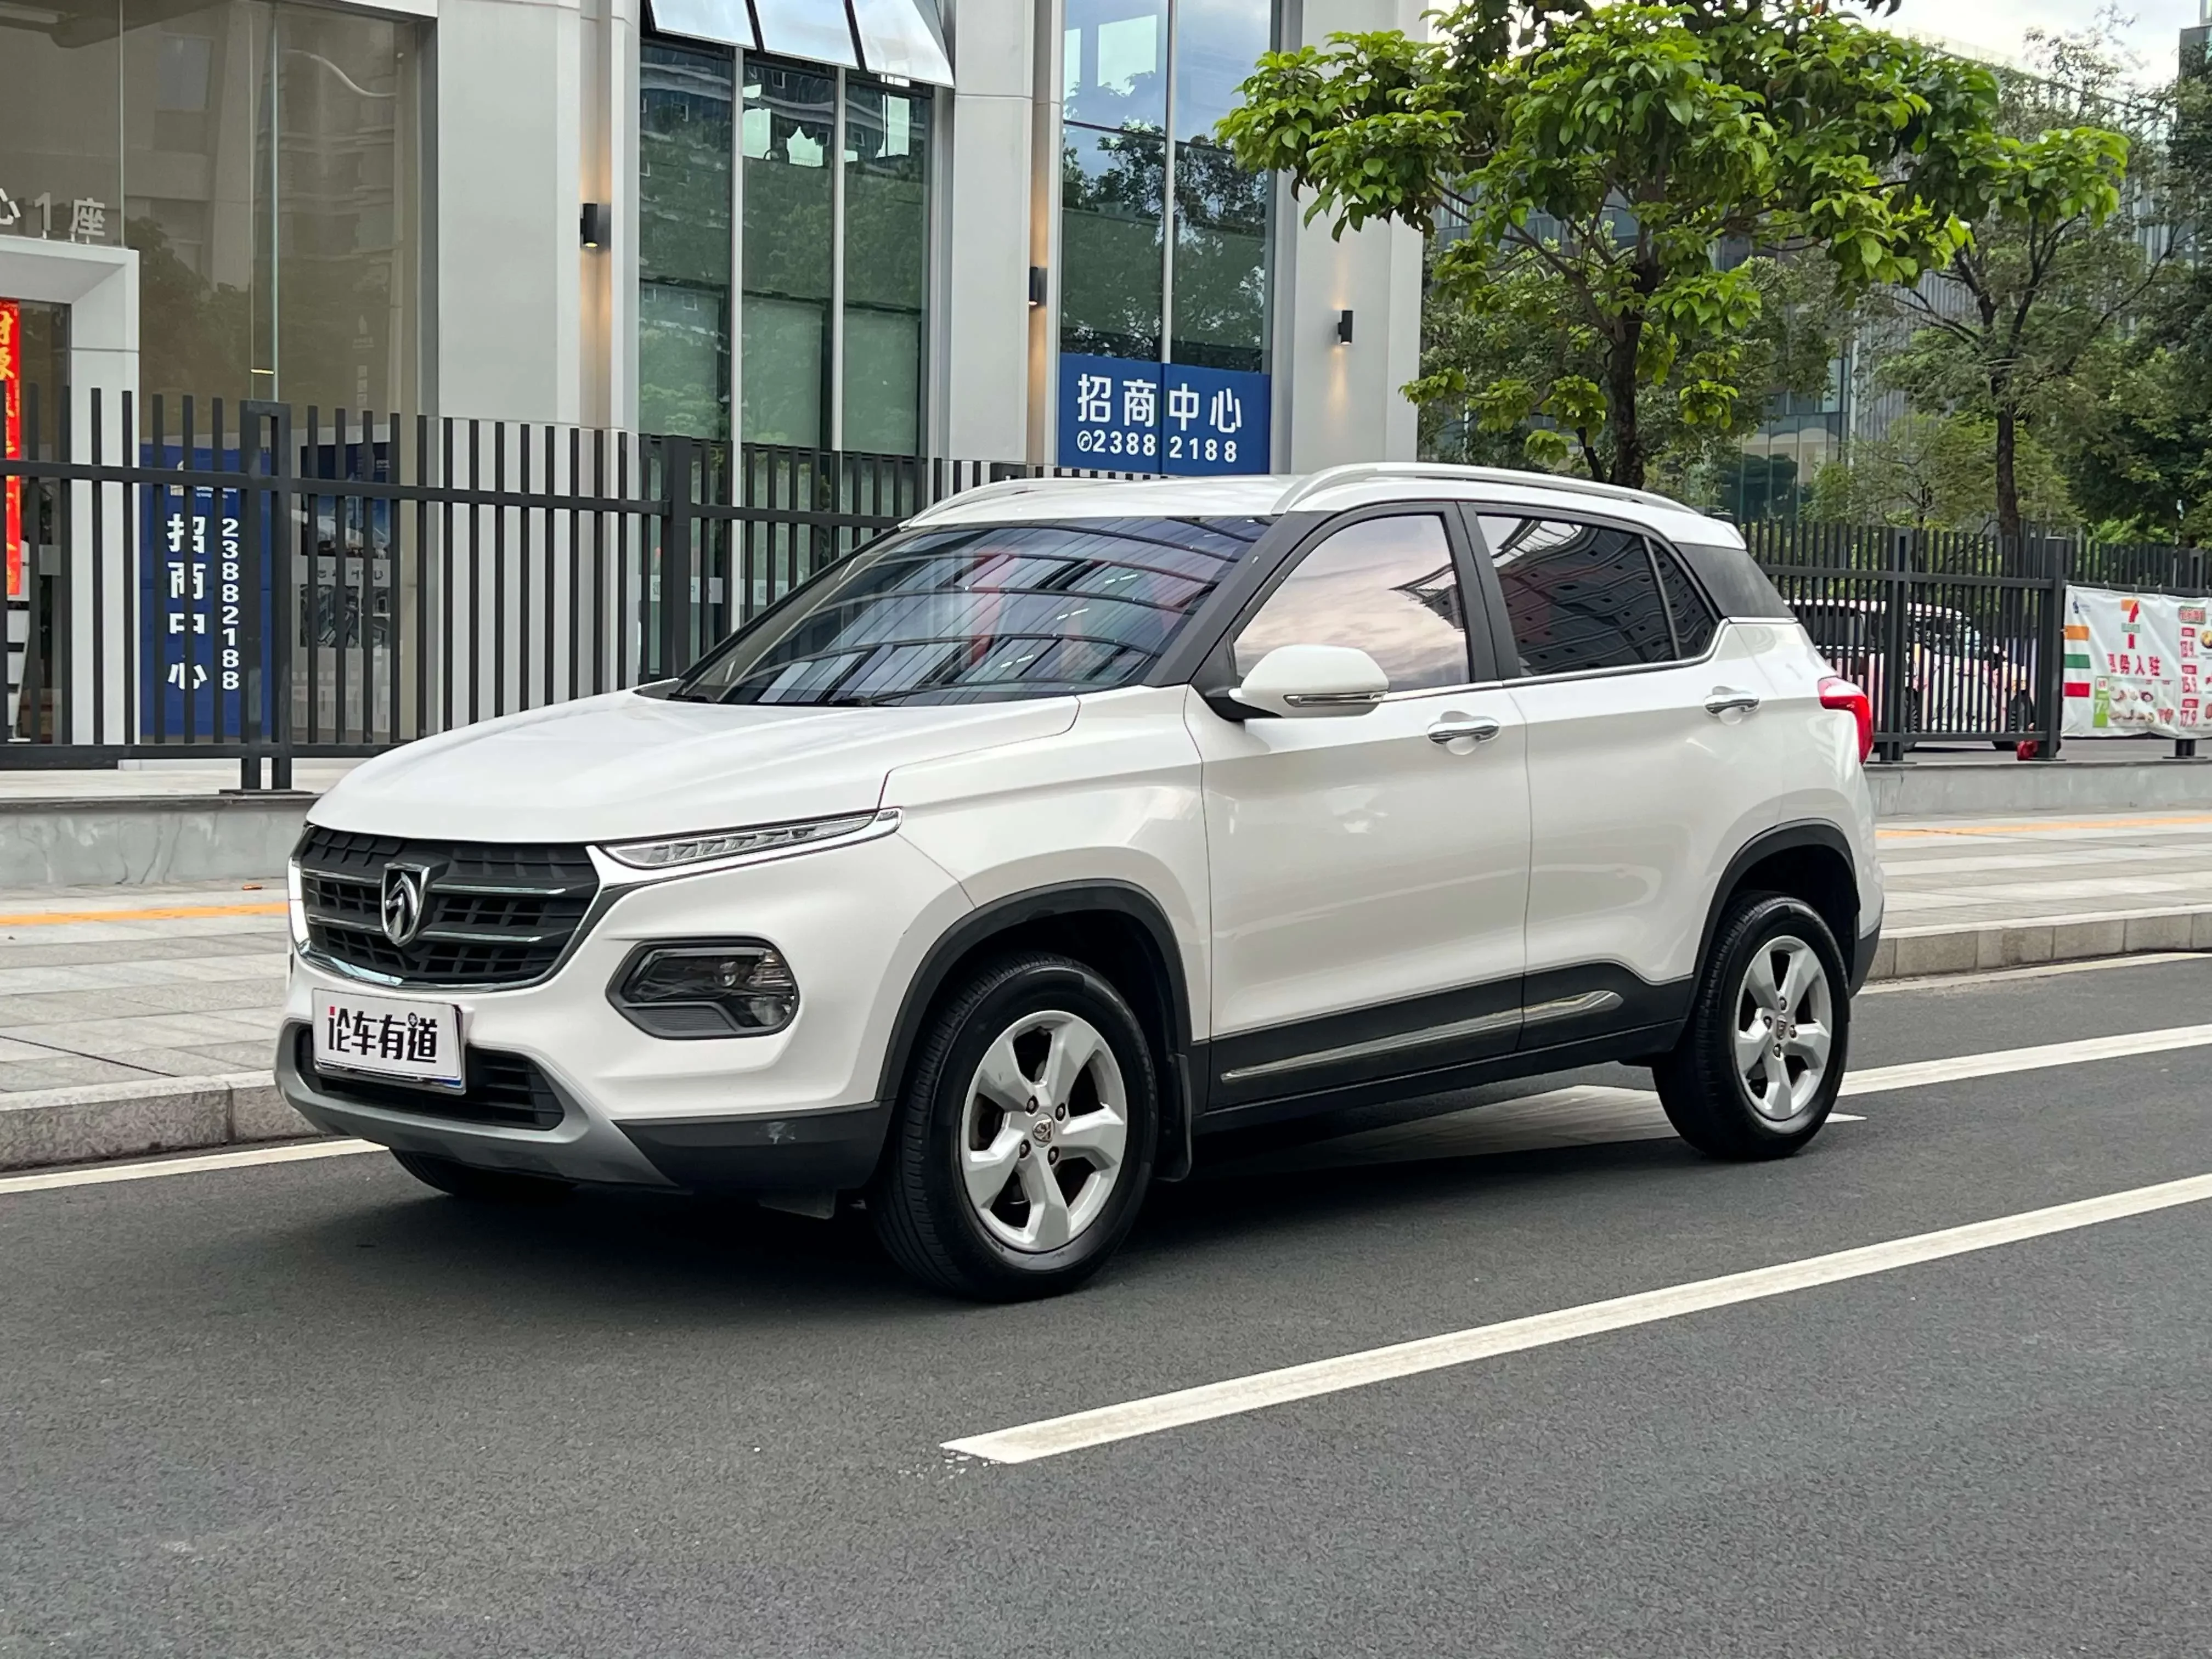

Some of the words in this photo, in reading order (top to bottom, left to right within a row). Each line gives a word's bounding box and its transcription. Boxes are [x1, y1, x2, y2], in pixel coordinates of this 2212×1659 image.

[1077, 373, 1242, 433] 招商中心
[1092, 430, 1156, 456] 2388
[1169, 436, 1237, 462] 2188
[222, 517, 239, 690] 23882188
[328, 1006, 438, 1063] 论车有道
